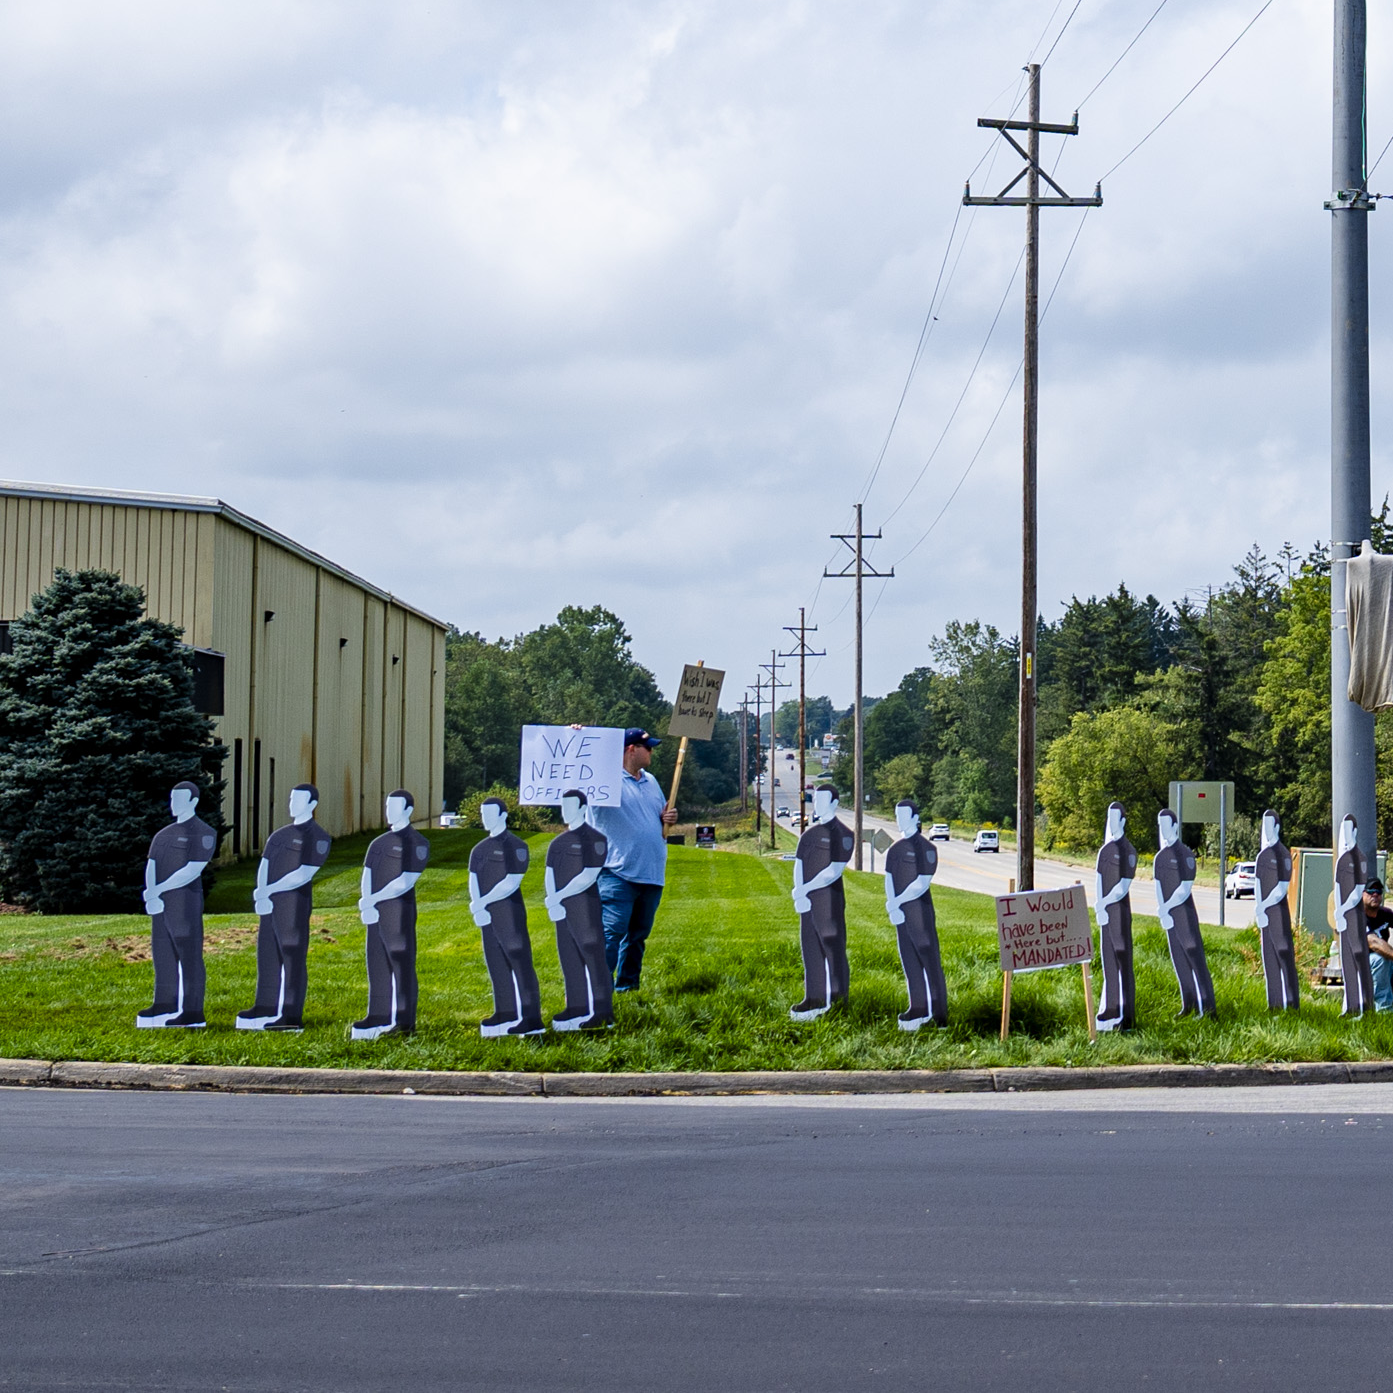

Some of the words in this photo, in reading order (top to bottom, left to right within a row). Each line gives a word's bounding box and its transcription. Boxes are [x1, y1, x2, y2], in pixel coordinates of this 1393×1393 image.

[700, 671, 706, 687] I
[542, 734, 601, 758] WE
[531, 760, 594, 781] NEED
[523, 785, 610, 801] OFFIRS
[999, 898, 1017, 917] I
[1026, 890, 1074, 913] Would
[1002, 922, 1036, 941] have
[1012, 937, 1092, 968] MANDATED!
